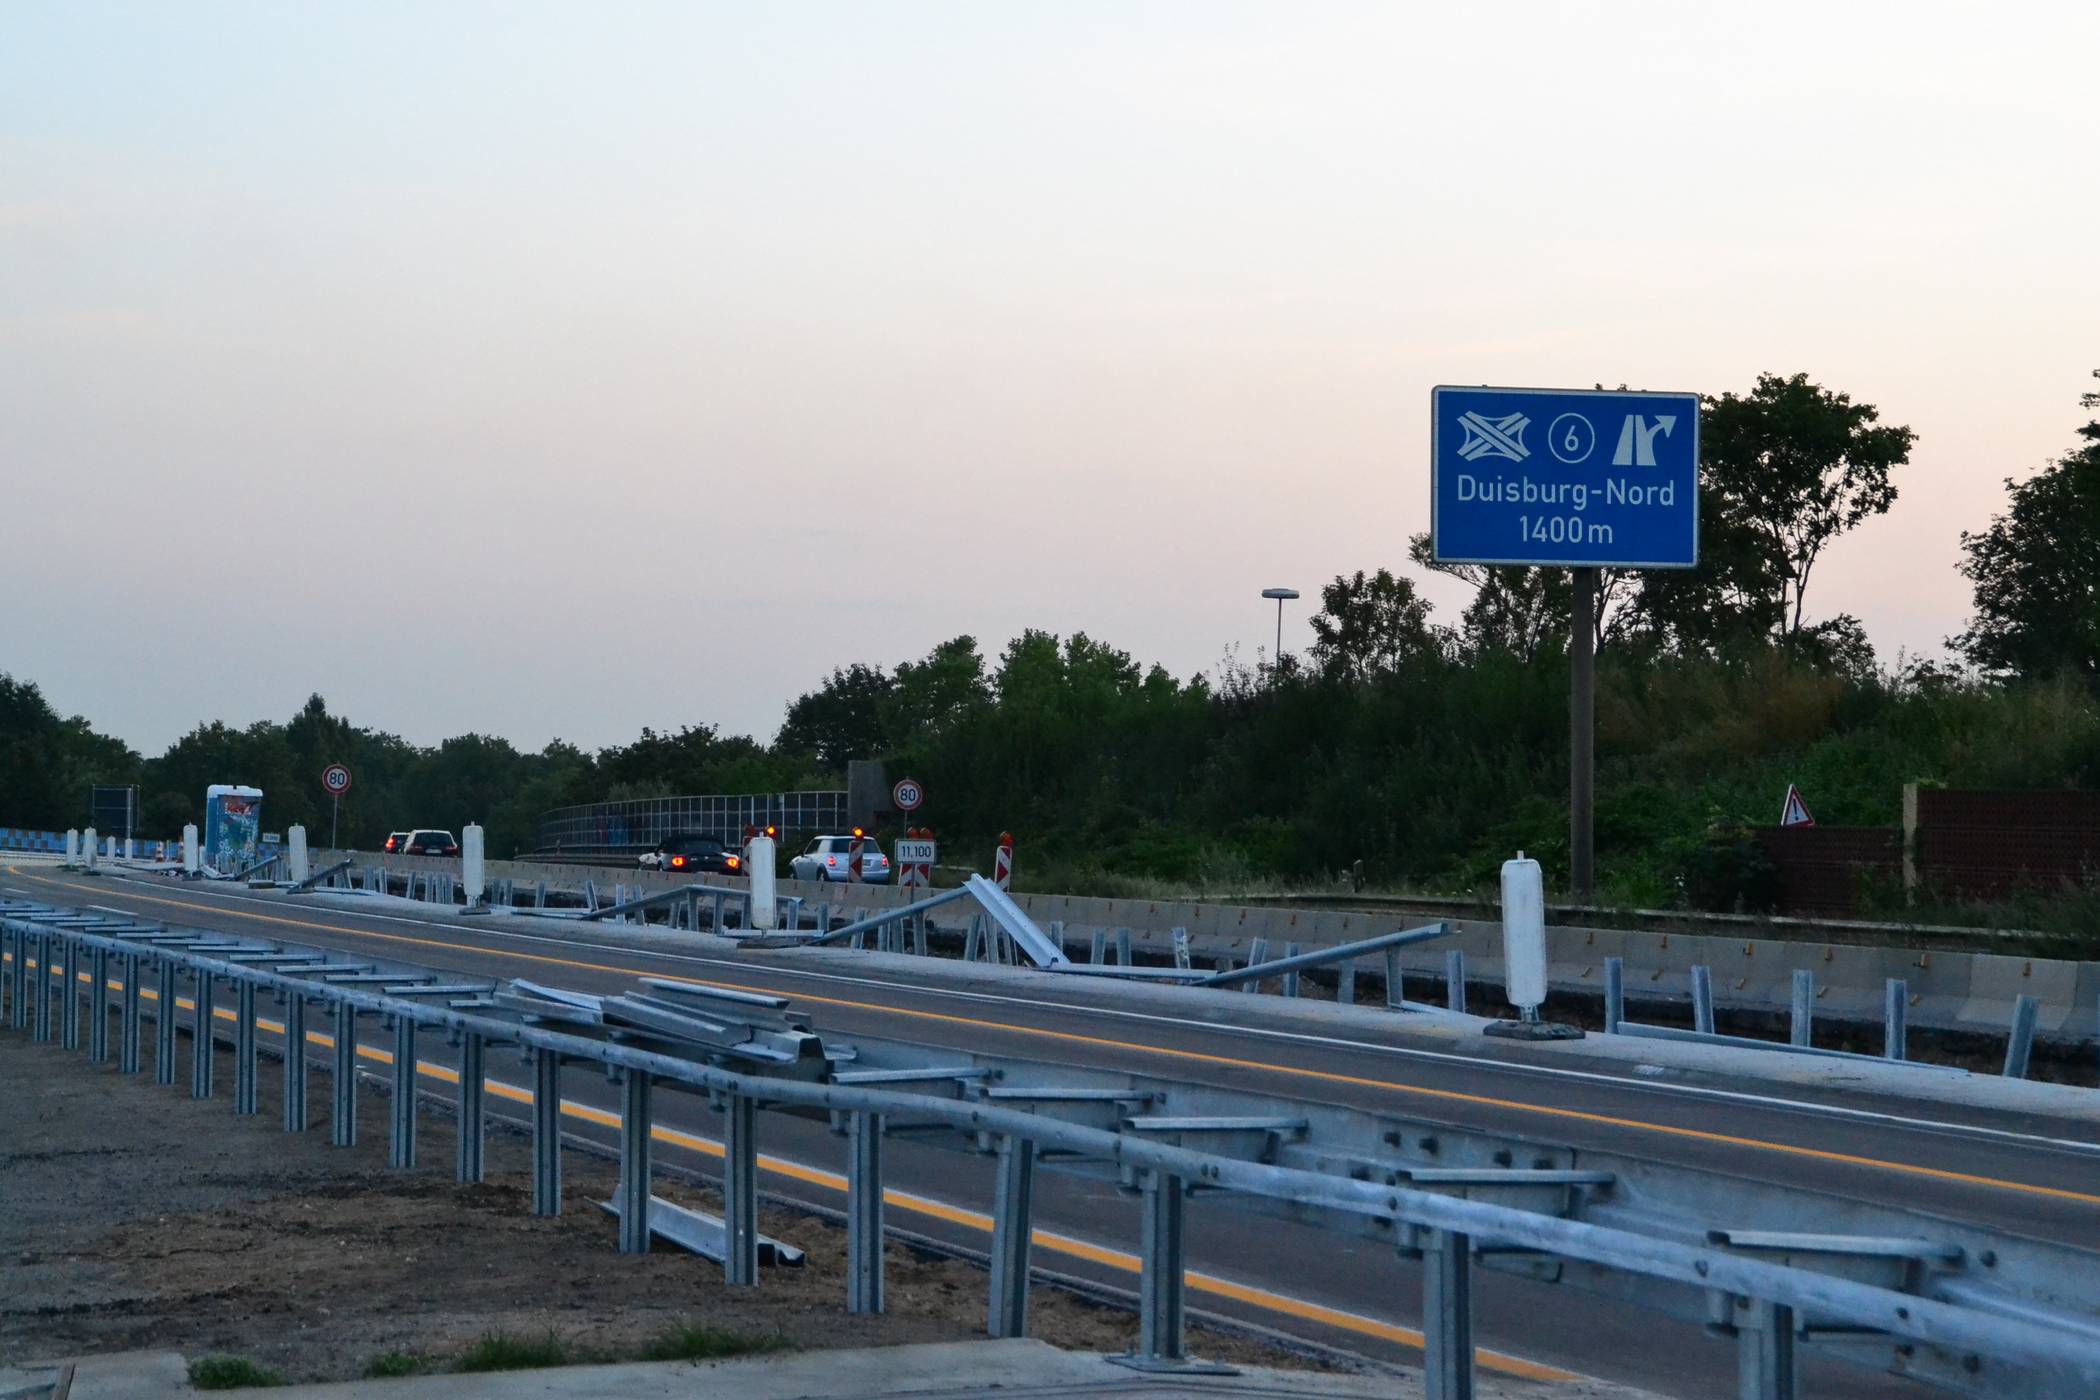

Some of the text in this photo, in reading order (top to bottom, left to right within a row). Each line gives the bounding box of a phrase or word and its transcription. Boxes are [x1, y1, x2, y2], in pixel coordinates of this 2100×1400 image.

[1563, 424, 1580, 452] 6
[1457, 474, 1675, 511] Duisburg-Nord
[329, 772, 345, 786] 80
[900, 788, 916, 802] 80
